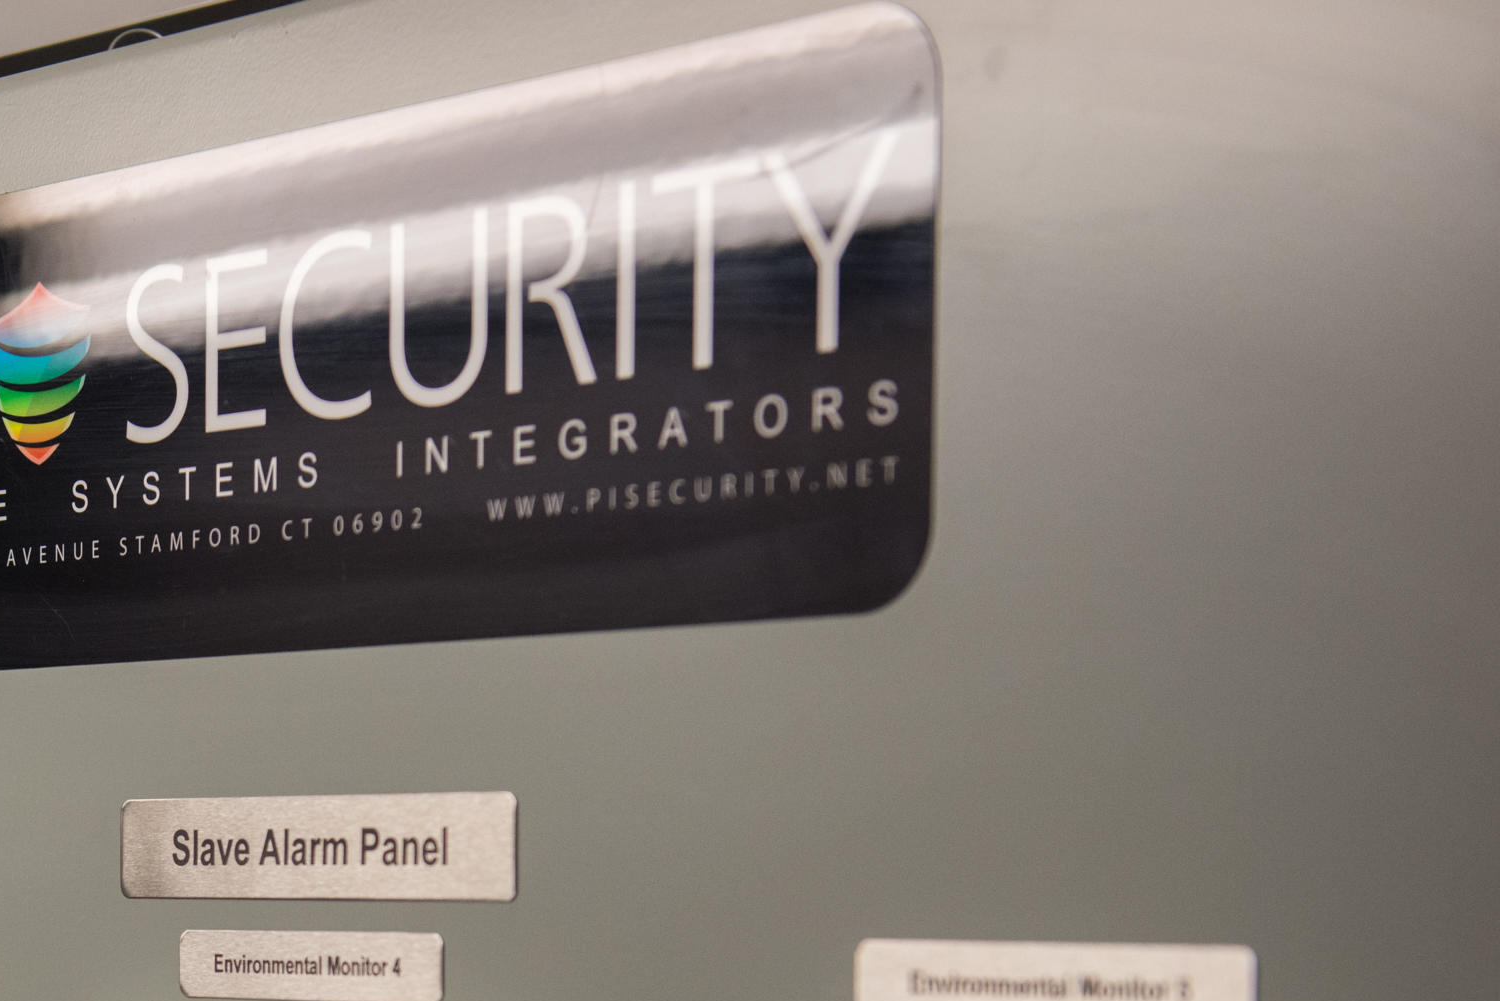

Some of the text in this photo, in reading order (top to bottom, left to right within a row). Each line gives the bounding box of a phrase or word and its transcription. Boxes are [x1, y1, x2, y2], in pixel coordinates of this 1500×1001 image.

[126, 127, 897, 444] SECURITY
[71, 452, 318, 513] SYSTEMS
[396, 380, 899, 478] INTEGRATORS
[6, 540, 100, 567] AVENUE
[119, 523, 261, 556] STAMFORD
[281, 517, 313, 541] CT
[332, 506, 422, 537] 06902
[487, 455, 899, 522] WWW.PISECURITY.NET
[172, 827, 448, 866] Slave Alarm Panel
[214, 953, 402, 977] Environmental Monitor 4
[908, 968, 1067, 998] Environmental
[1078, 974, 1169, 1001] Monitor
